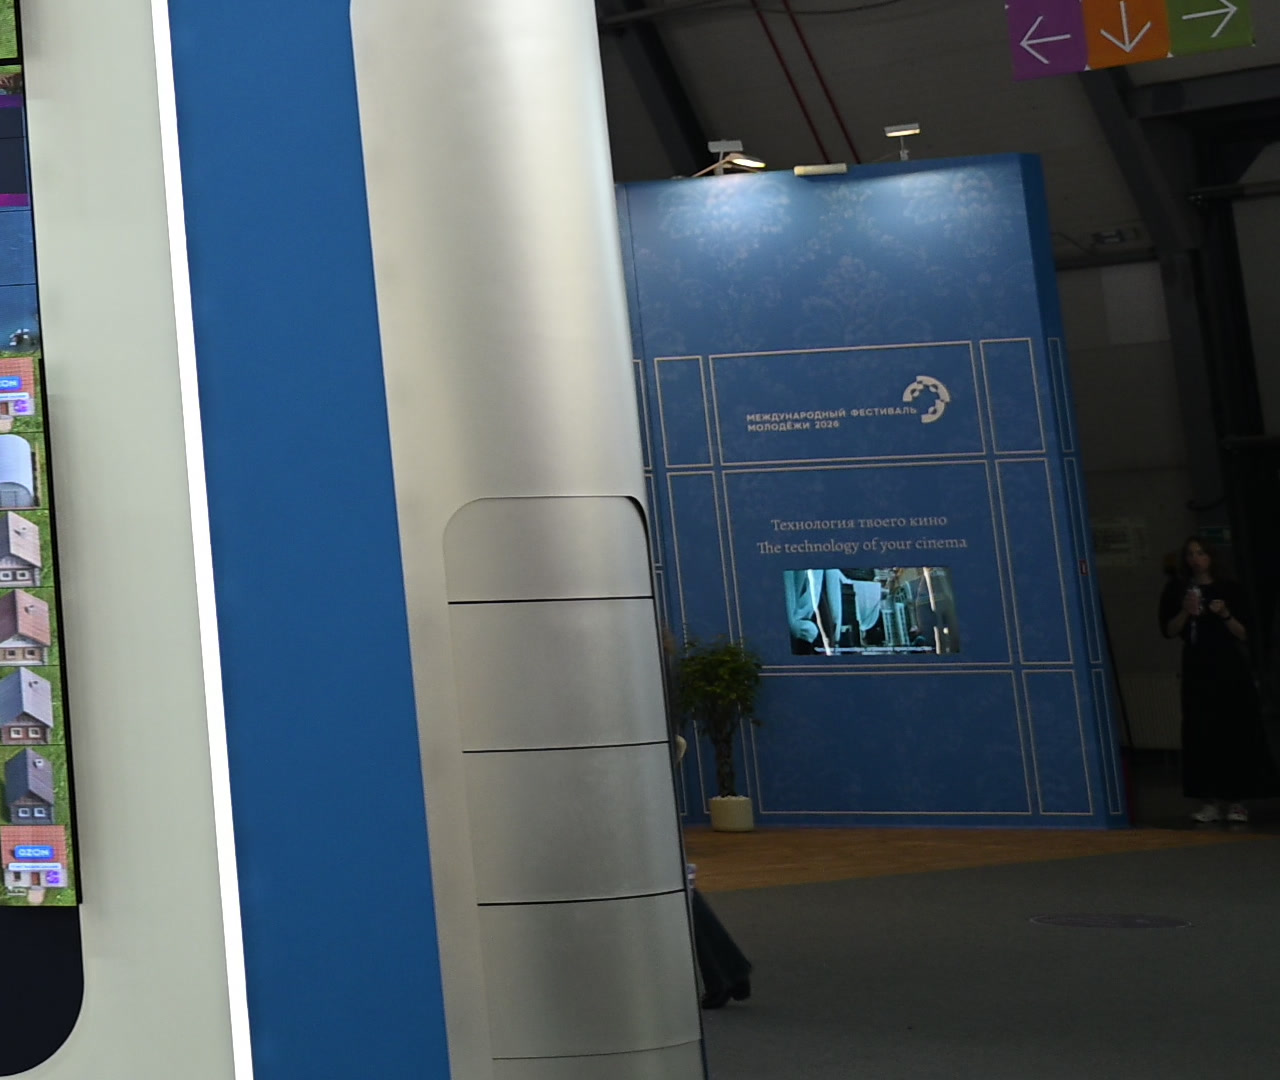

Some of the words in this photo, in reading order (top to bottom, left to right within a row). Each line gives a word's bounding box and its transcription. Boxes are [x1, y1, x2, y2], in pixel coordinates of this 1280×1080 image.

[746, 408, 846, 422] МЕЖДУНАРОДНЫЙ
[850, 406, 917, 417] ФЕСТИВАЛЬ
[747, 422, 810, 433] МОЛОДЁЖИ
[815, 420, 840, 429] 2026
[771, 517, 855, 533] Технология
[858, 516, 906, 531] твоего
[910, 515, 947, 526] кино
[757, 541, 782, 555] The
[784, 540, 860, 556] technology
[863, 537, 878, 551] of
[879, 539, 913, 554] your
[915, 537, 968, 550] cinema
